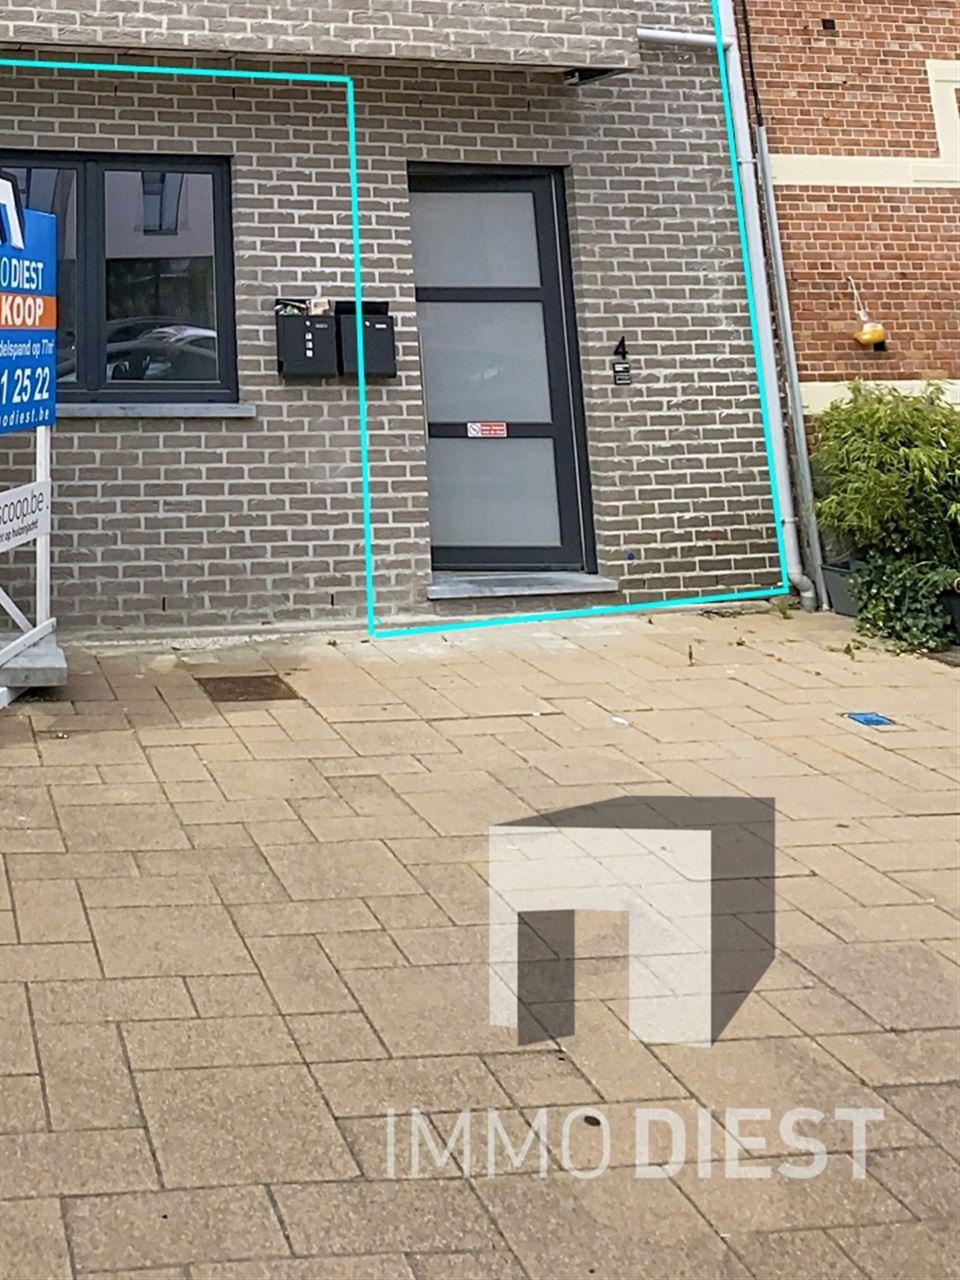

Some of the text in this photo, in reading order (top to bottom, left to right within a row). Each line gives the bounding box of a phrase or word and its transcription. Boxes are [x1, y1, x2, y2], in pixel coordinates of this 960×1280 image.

[1, 295, 44, 326] KOOP
[31, 343, 42, 359] op
[613, 335, 629, 360] 4
[11, 368, 33, 404] 25
[33, 365, 51, 401] 22
